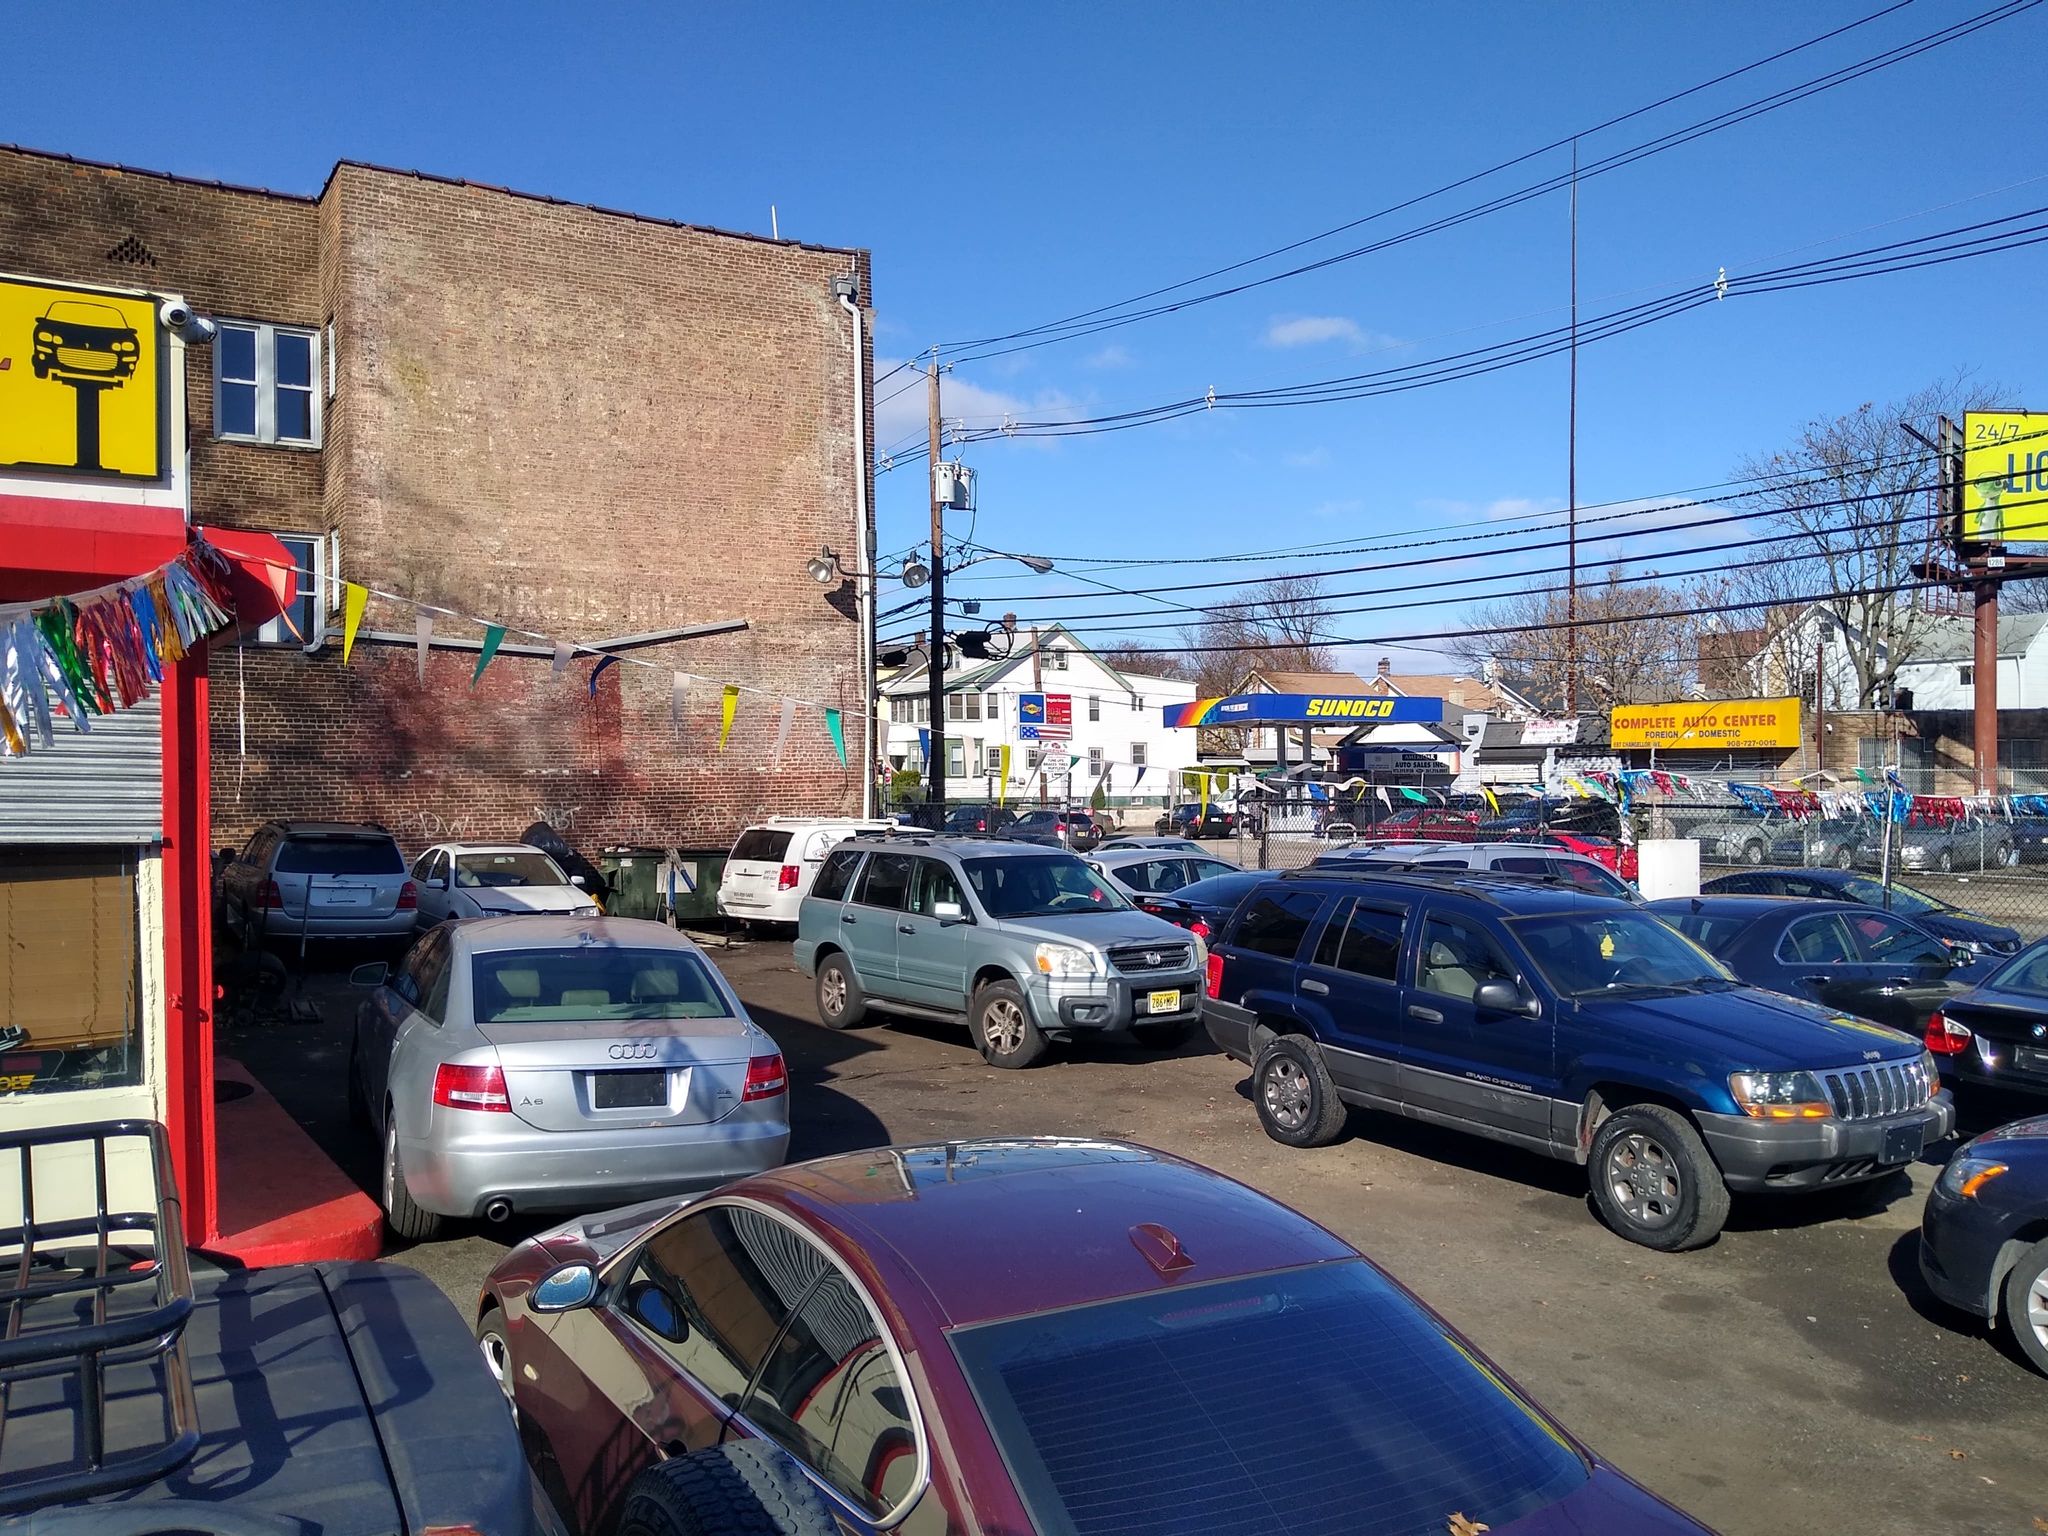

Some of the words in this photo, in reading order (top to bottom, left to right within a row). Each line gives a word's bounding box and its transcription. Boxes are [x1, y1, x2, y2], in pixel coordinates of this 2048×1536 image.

[1975, 422, 2020, 440] 24/7
[1306, 699, 1395, 718] SUNOCO
[1614, 717, 1676, 729] COMPLETE
[1683, 715, 1718, 728] AUTO
[1723, 714, 1777, 727] CENTER
[1645, 730, 1679, 739] FOREIGN
[1698, 729, 1741, 738] DOMESTIC
[1726, 739, 1777, 747] 908-727-0012
[1466, 1072, 1491, 1081] GRAND
[1492, 1078, 1532, 1091] CHEROKEE
[520, 1096, 544, 1106] A6
